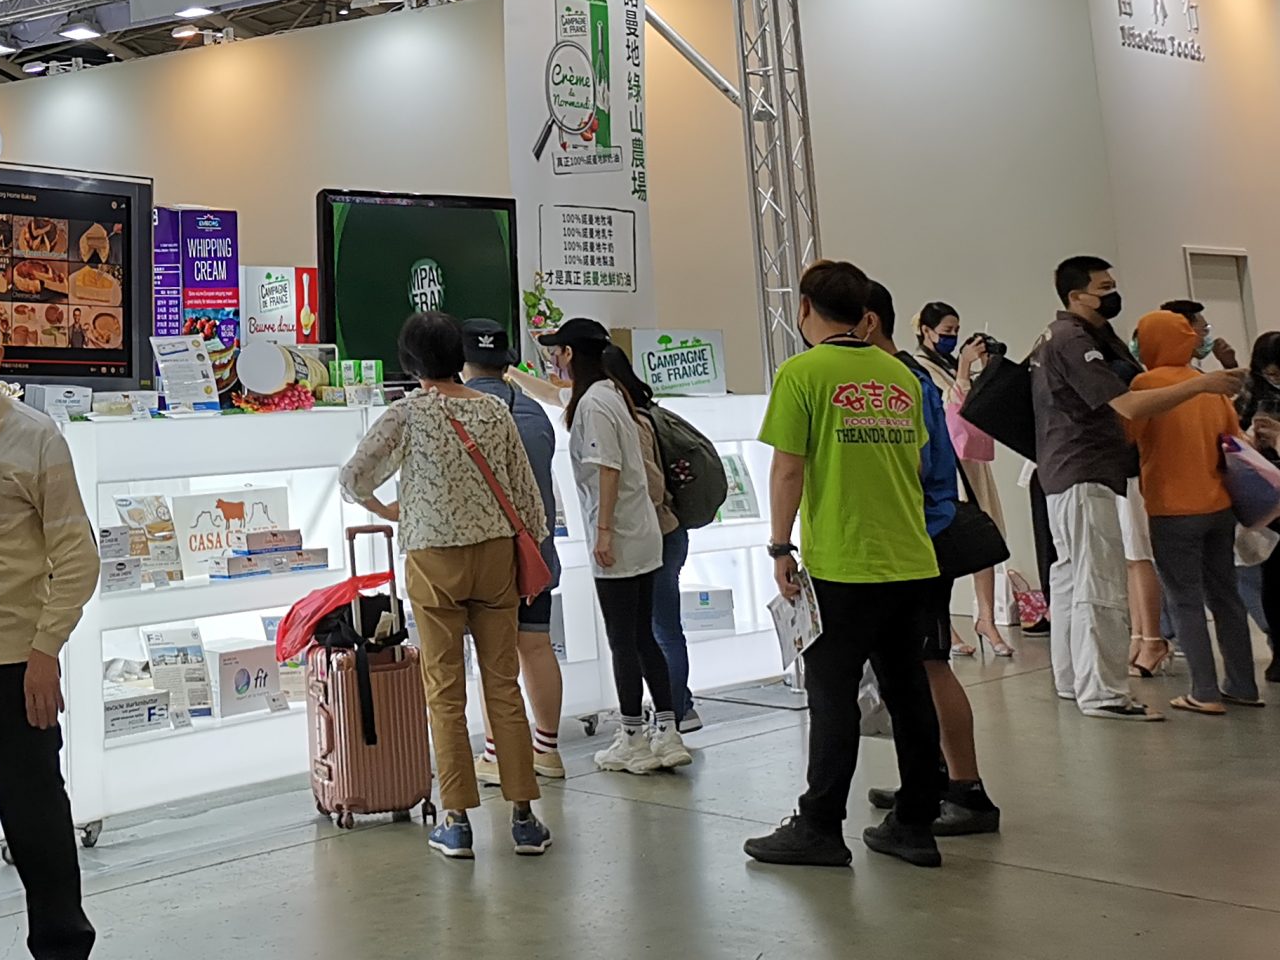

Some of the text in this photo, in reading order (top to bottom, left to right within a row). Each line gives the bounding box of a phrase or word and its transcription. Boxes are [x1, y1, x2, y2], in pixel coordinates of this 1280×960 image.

[561, 14, 587, 26] CAMPAGNE
[551, 63, 592, 89] Crème
[552, 93, 592, 111] Normandi
[187, 238, 232, 258] WHIPPING
[194, 261, 227, 281] CREAM
[260, 284, 288, 300] CAMPAGNE
[262, 293, 288, 309] DE FRANCE
[248, 315, 296, 334] Beurre doux
[647, 348, 709, 372] CAMPAGNE
[651, 362, 709, 384] DE FRANCE
[844, 417, 876, 427] FOOD
[189, 531, 223, 553] CASA
[254, 668, 269, 689] fit
